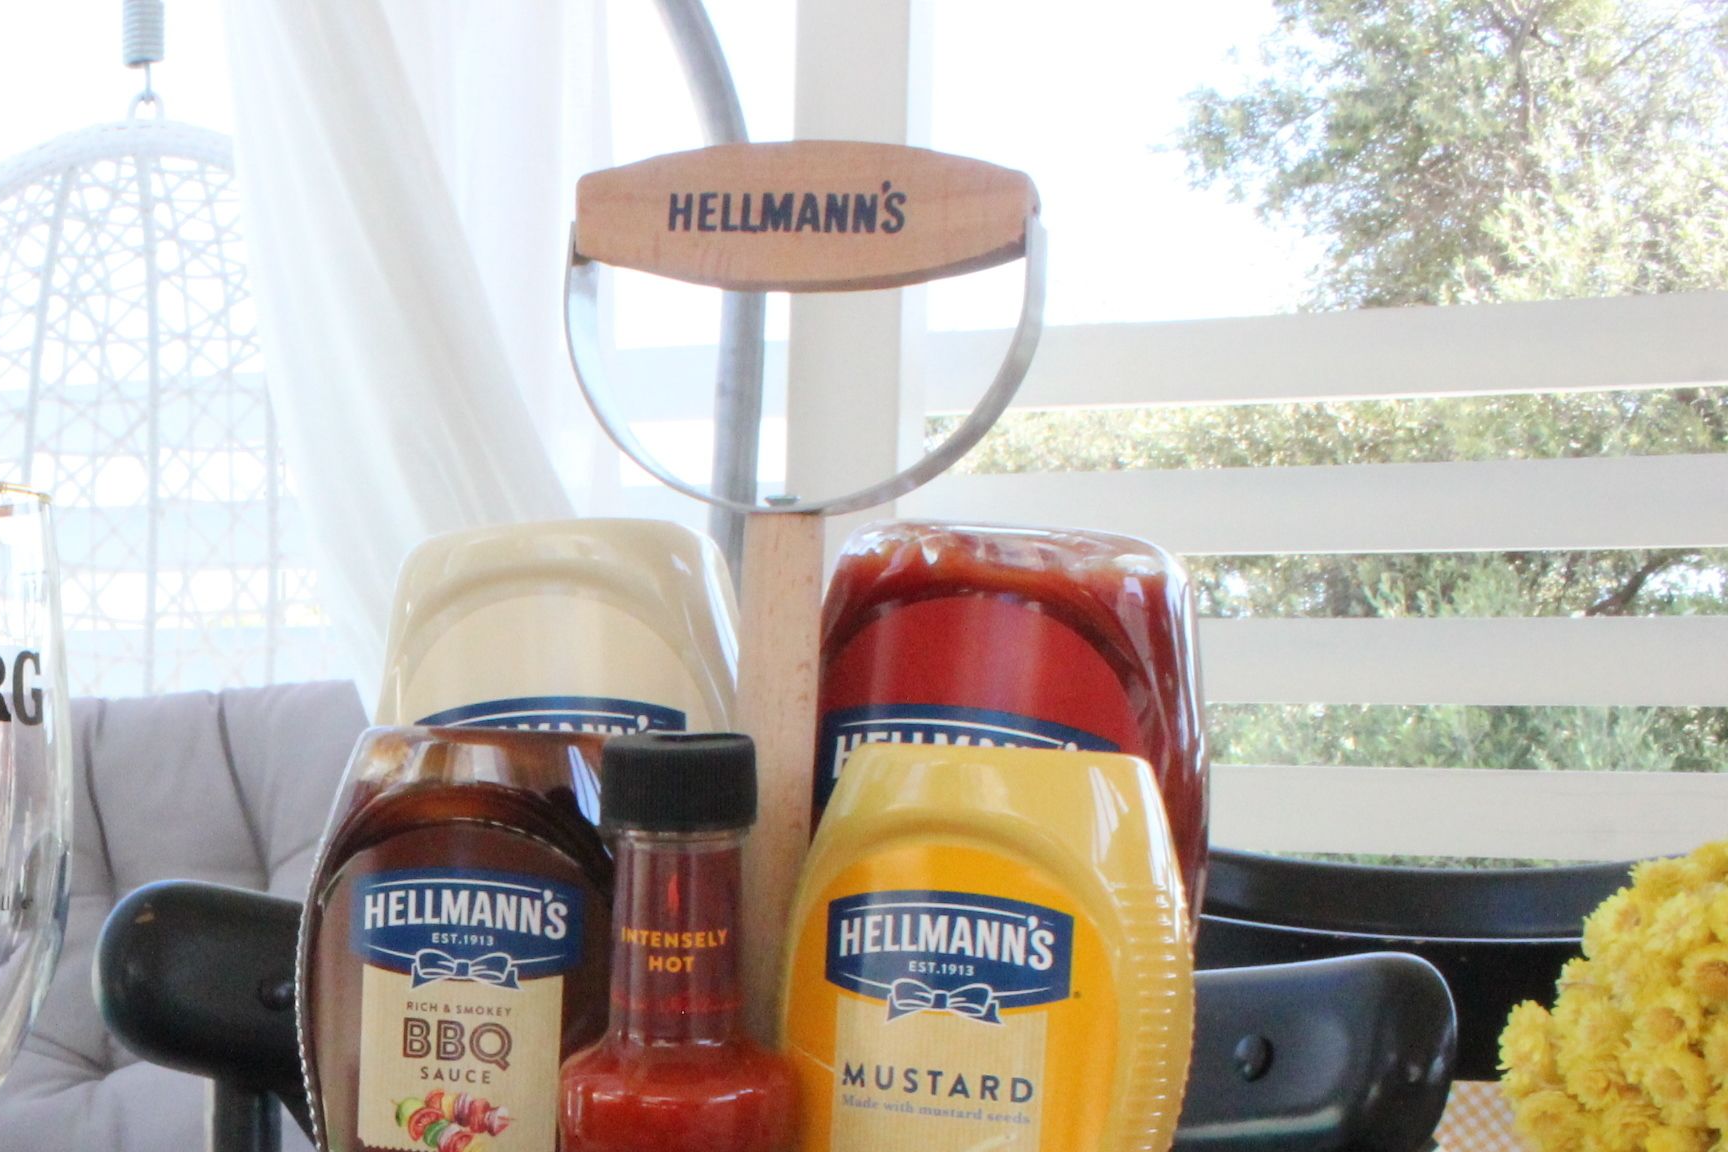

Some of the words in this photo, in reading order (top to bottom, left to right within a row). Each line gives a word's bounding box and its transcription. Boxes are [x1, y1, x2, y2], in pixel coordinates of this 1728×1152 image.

[668, 181, 908, 234] HELLMANN'S
[364, 889, 569, 940] HELLMANN'S
[431, 932, 495, 947] EST.1913
[621, 926, 727, 948] INTENSELY
[839, 915, 1055, 971] HELLMANN'S
[648, 954, 695, 973] HOT
[908, 960, 975, 977] EST.1913
[406, 1001, 438, 1013] RICH
[442, 1002, 451, 1013] &
[456, 1004, 513, 1017] SMOKEY
[401, 1017, 514, 1071] BBQ
[420, 1066, 492, 1085] SAUCE
[841, 1062, 1034, 1103] MUSTARD
[841, 1094, 878, 1108] Made
[884, 1101, 913, 1114] with
[919, 1106, 982, 1121] mustard
[987, 1112, 1030, 1125] seeds
